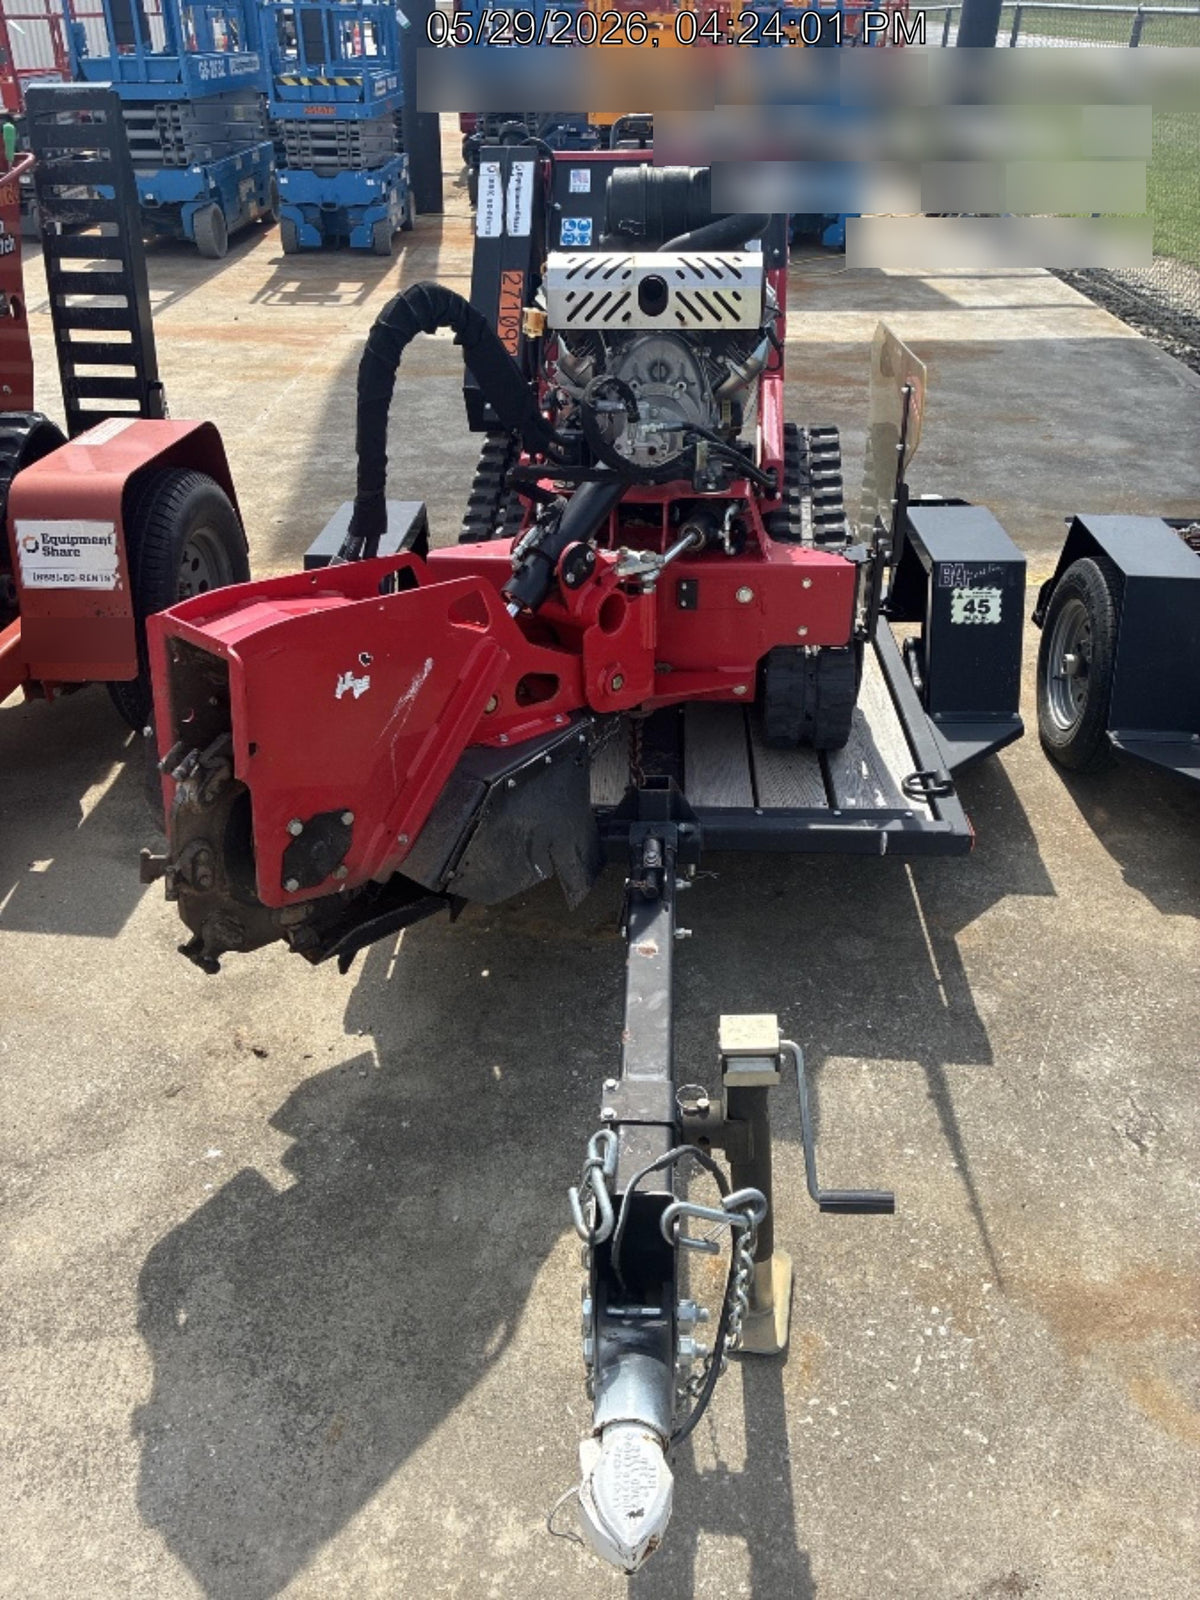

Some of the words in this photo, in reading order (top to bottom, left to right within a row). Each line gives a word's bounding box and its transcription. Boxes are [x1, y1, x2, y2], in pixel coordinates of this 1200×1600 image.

[41, 533, 112, 546] Equipment
[41, 546, 81, 557] Share
[963, 599, 991, 614] 45
